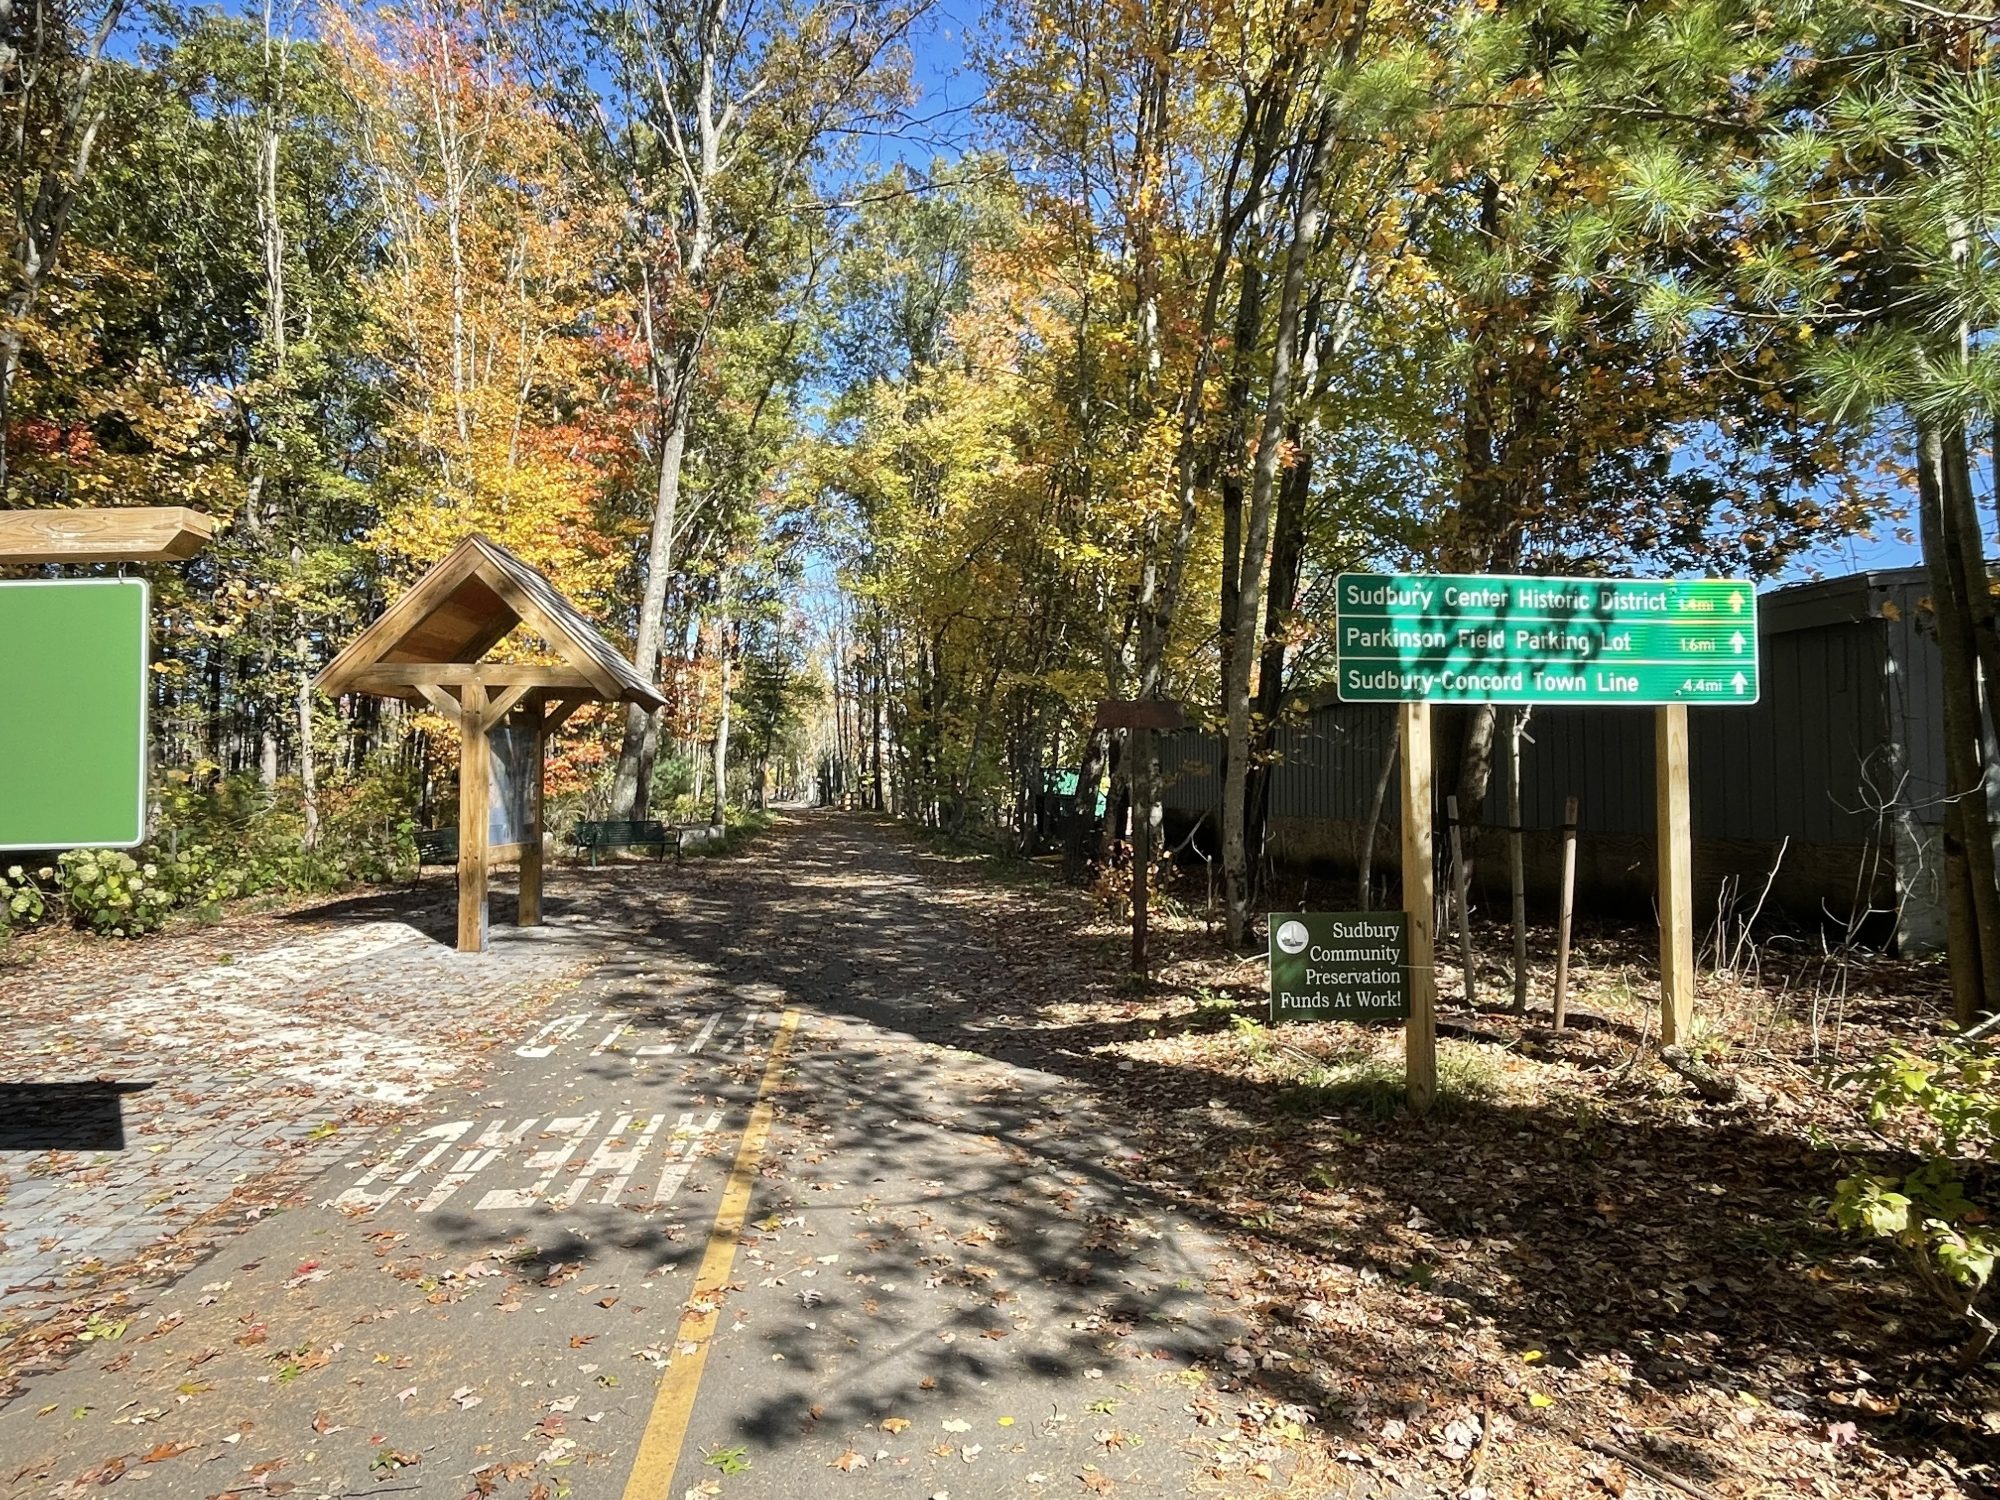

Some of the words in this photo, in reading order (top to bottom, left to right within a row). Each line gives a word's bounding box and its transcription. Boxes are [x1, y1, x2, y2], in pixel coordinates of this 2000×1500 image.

[1347, 585, 1433, 610] Sudbury
[1445, 587, 1508, 607] Center
[1519, 589, 1590, 609] Historic
[1601, 592, 1667, 611] District
[1347, 628, 1446, 648] Parkinson
[1458, 629, 1504, 649] Field
[1516, 631, 1589, 656] Parking
[1601, 633, 1631, 651] Lot
[1681, 637, 1716, 652] 1.6mi
[1349, 670, 1523, 695] Sudbury-Concord
[1534, 672, 1587, 692] Town
[1597, 673, 1639, 692] Line
[1682, 679, 1723, 694] 4.4mi
[1333, 922, 1400, 942] Sudbury
[1309, 945, 1401, 965] Community
[1305, 968, 1401, 985] Preservation
[1280, 992, 1330, 1009] Funds
[1334, 992, 1352, 1008] At
[1355, 991, 1402, 1007] Work!
